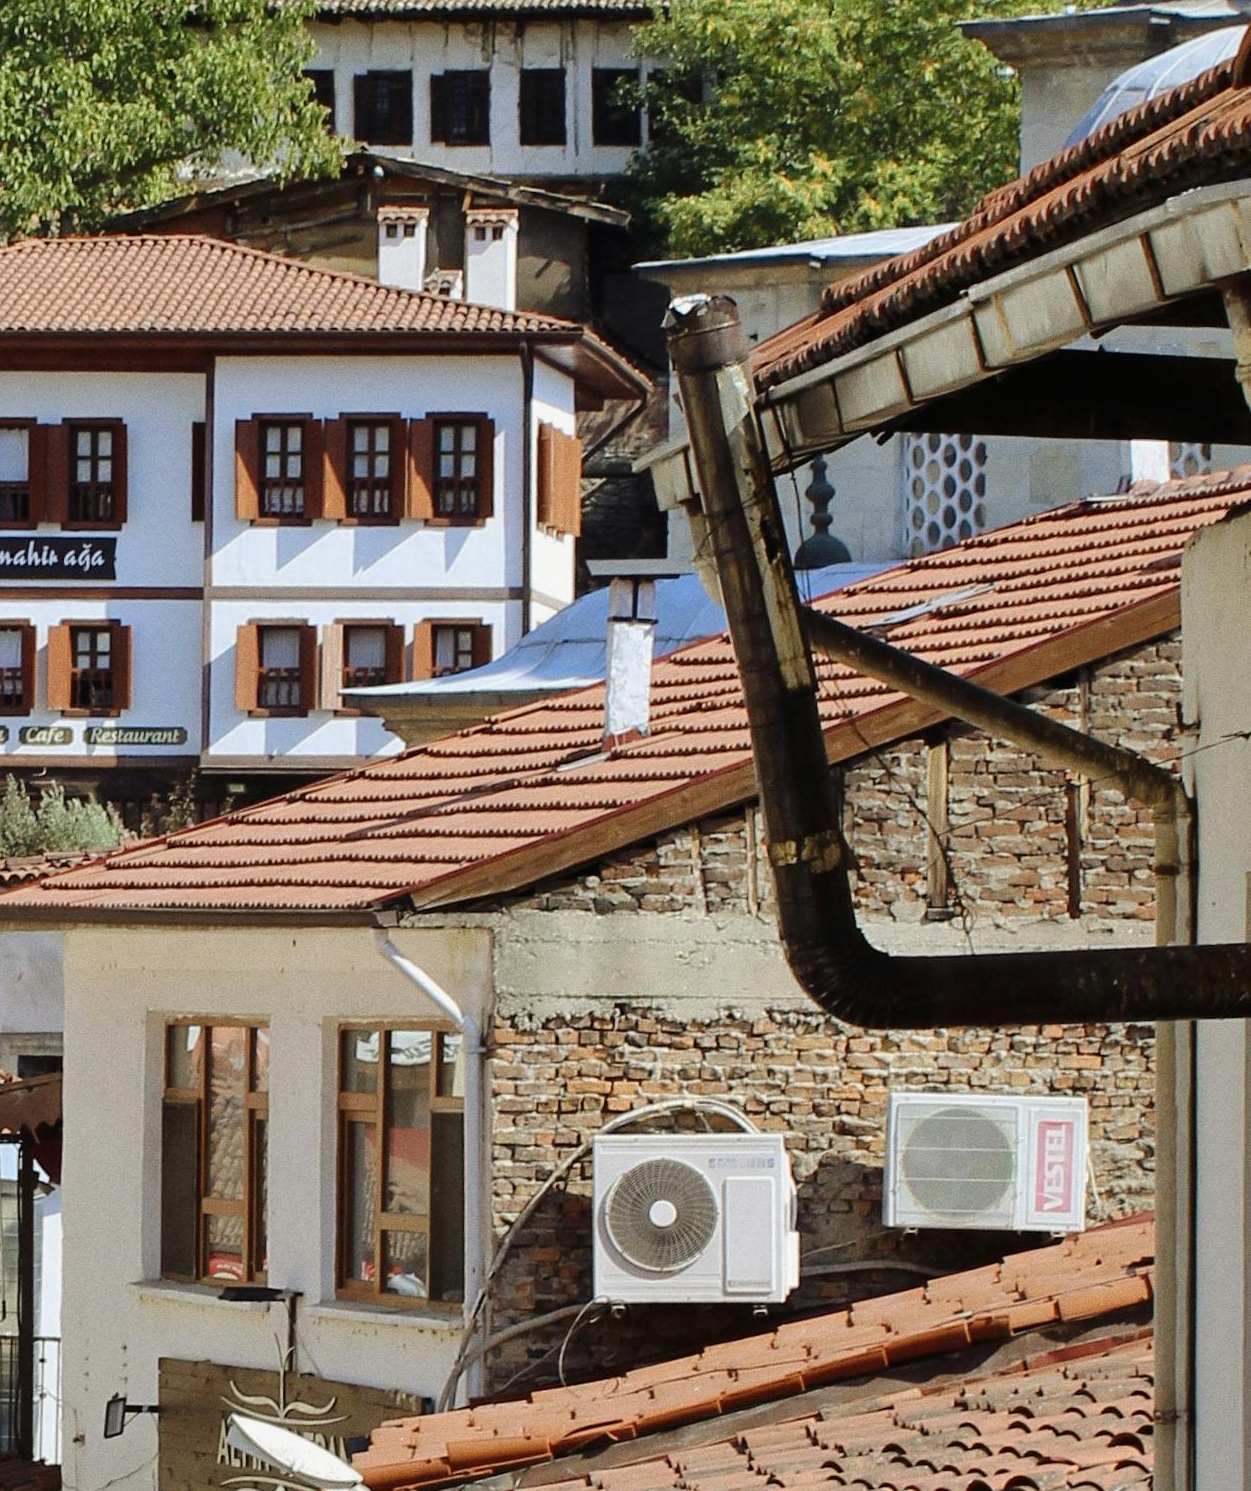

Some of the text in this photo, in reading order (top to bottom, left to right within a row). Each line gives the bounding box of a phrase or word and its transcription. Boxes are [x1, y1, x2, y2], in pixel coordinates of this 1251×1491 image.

[63, 543, 105, 572] ağa
[26, 727, 65, 744] Cafe
[90, 727, 180, 744] Restaurant
[1043, 1123, 1066, 1212] VESTEL
